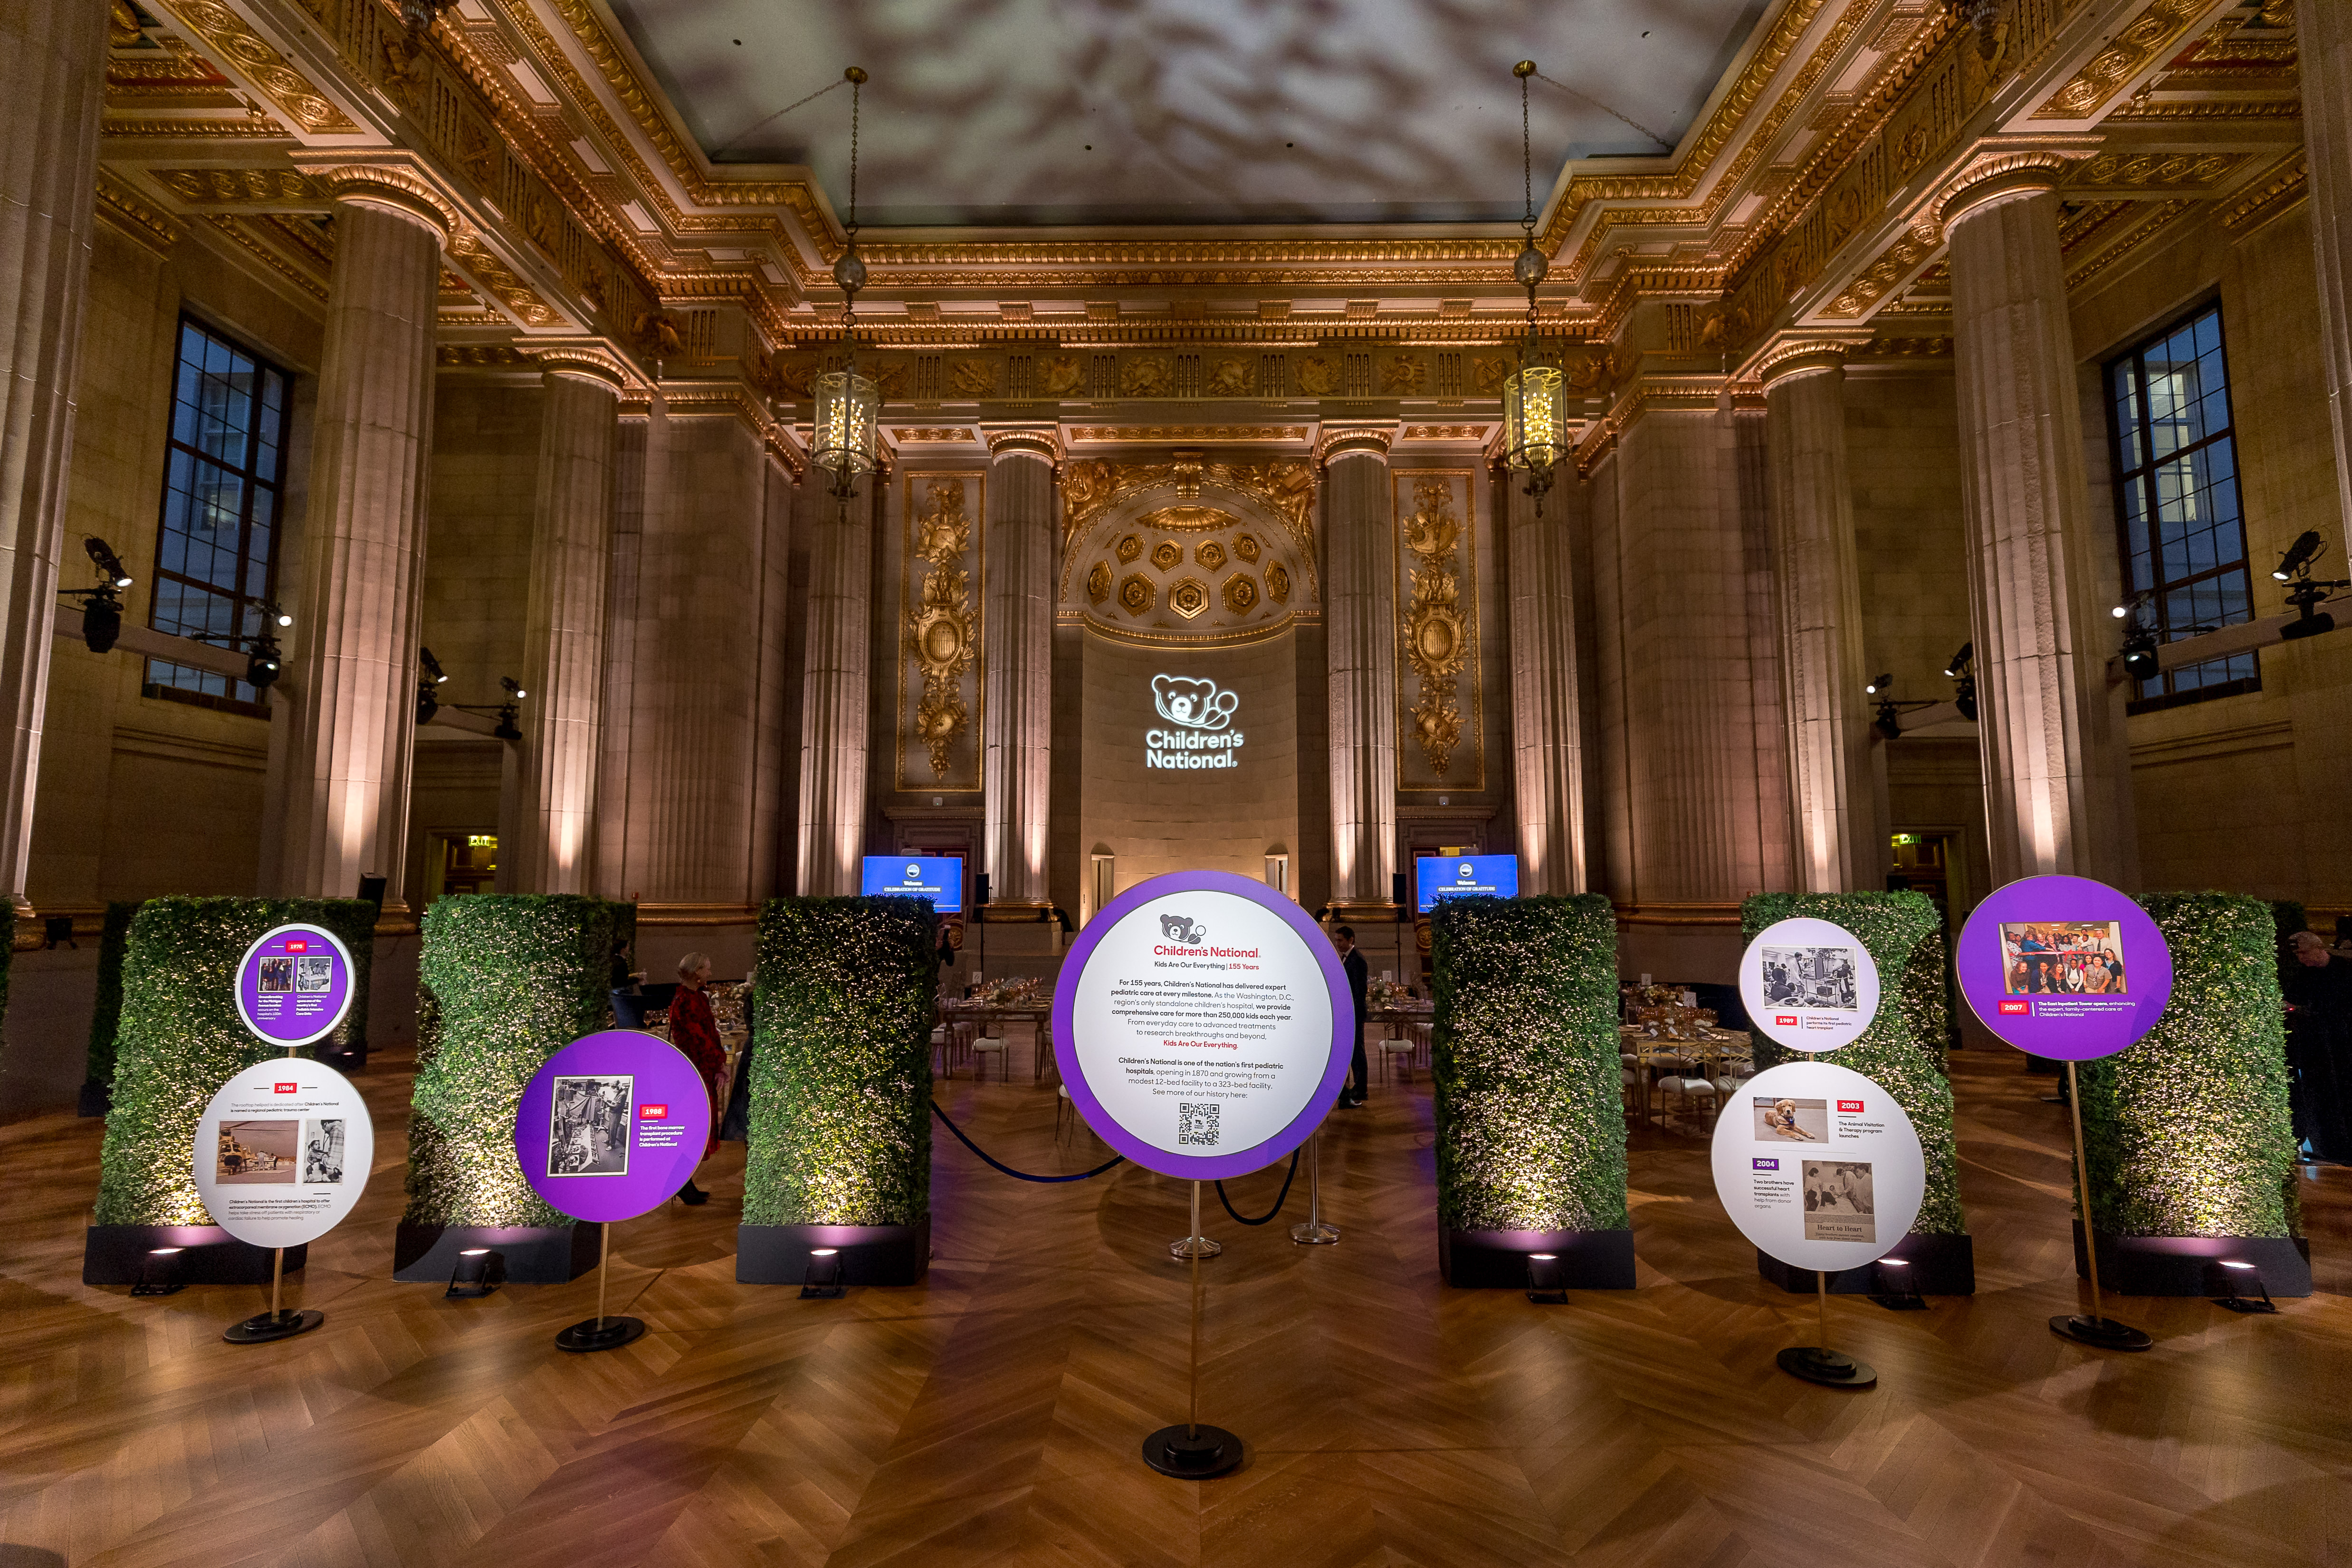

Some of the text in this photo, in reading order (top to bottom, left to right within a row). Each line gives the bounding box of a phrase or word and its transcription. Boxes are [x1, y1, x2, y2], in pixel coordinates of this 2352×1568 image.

[1146, 730, 1244, 749] Children's
[471, 836, 488, 845] EXIT
[1902, 835, 1918, 843] EXIT
[1154, 945, 1208, 956] Children's
[1175, 1031, 1224, 1039] breakthroughs
[1204, 1041, 1238, 1050] Everything.
[1182, 1080, 1203, 1088] facility
[1249, 1082, 1272, 1090] facility.
